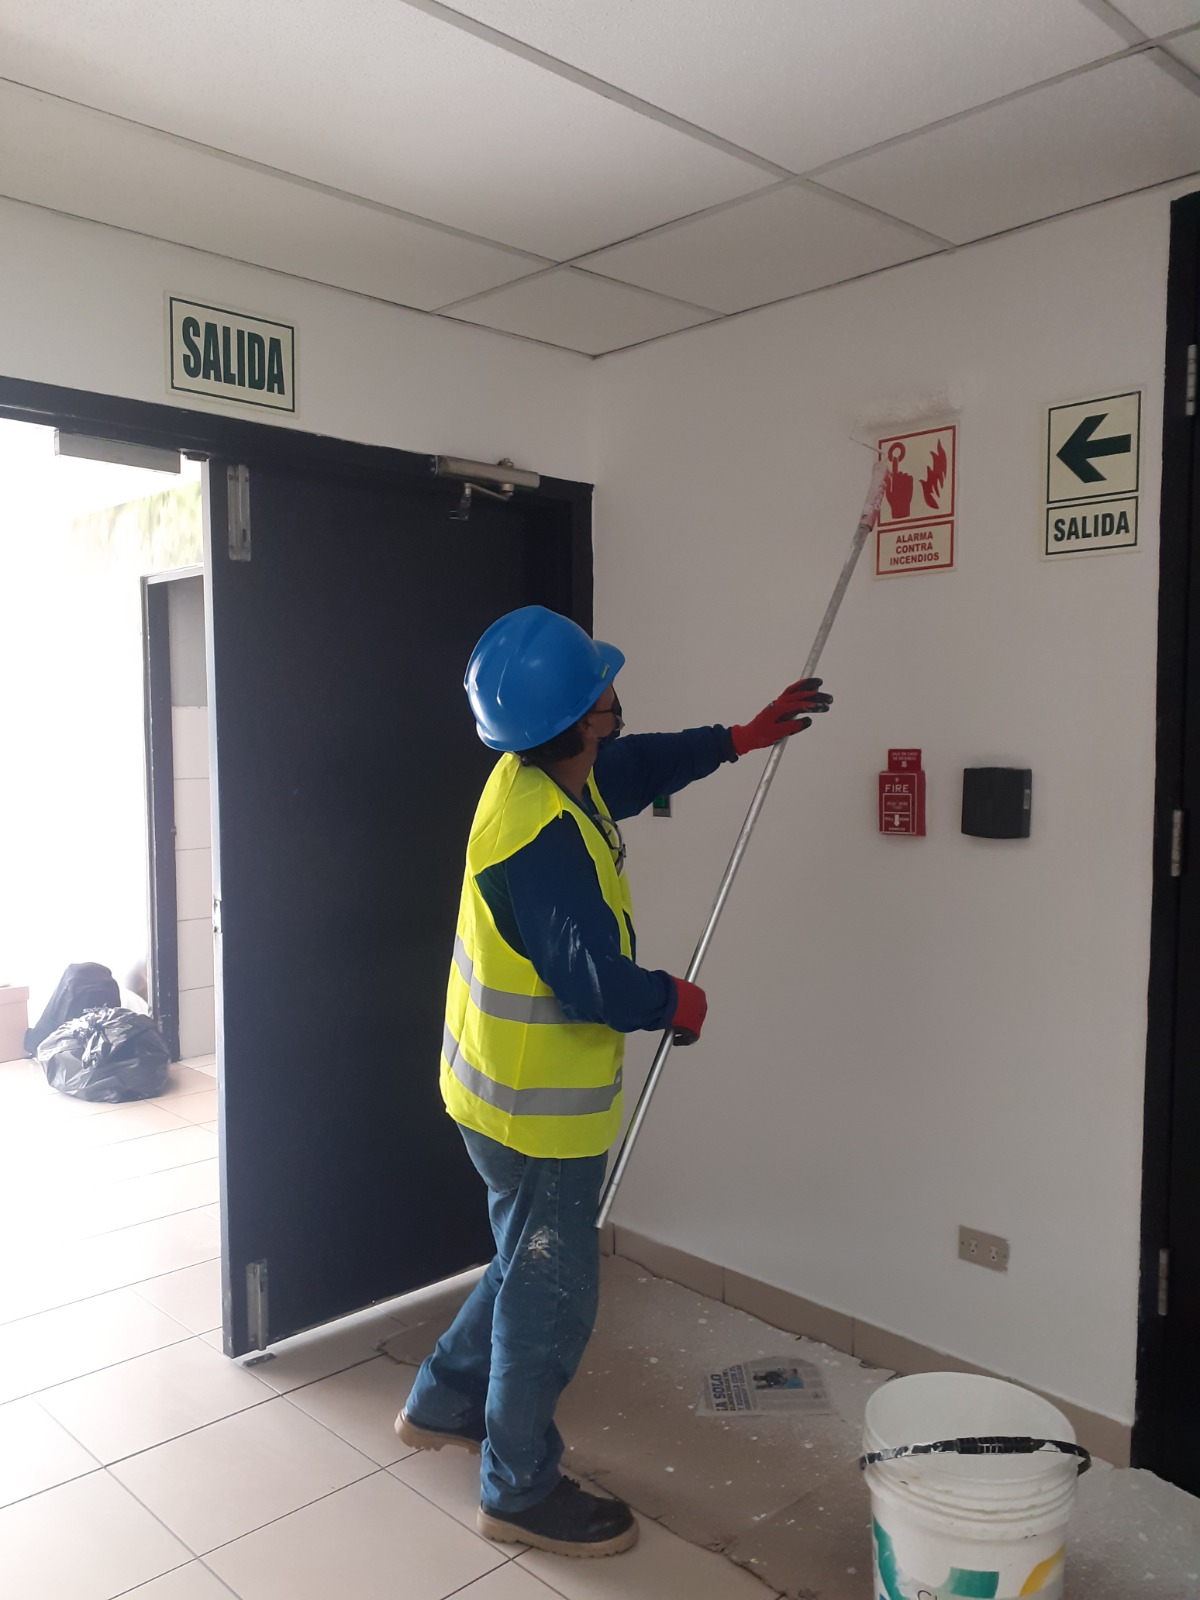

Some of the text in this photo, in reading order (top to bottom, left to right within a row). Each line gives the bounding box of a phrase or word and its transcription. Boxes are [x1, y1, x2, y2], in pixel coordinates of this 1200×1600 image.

[182, 316, 285, 395] SALIDA
[1053, 511, 1130, 542] SALIDA
[896, 531, 933, 544] ALARMA
[895, 542, 933, 554] CONTRA
[889, 552, 940, 566] INCENDIOS
[885, 784, 909, 793] FIRE
